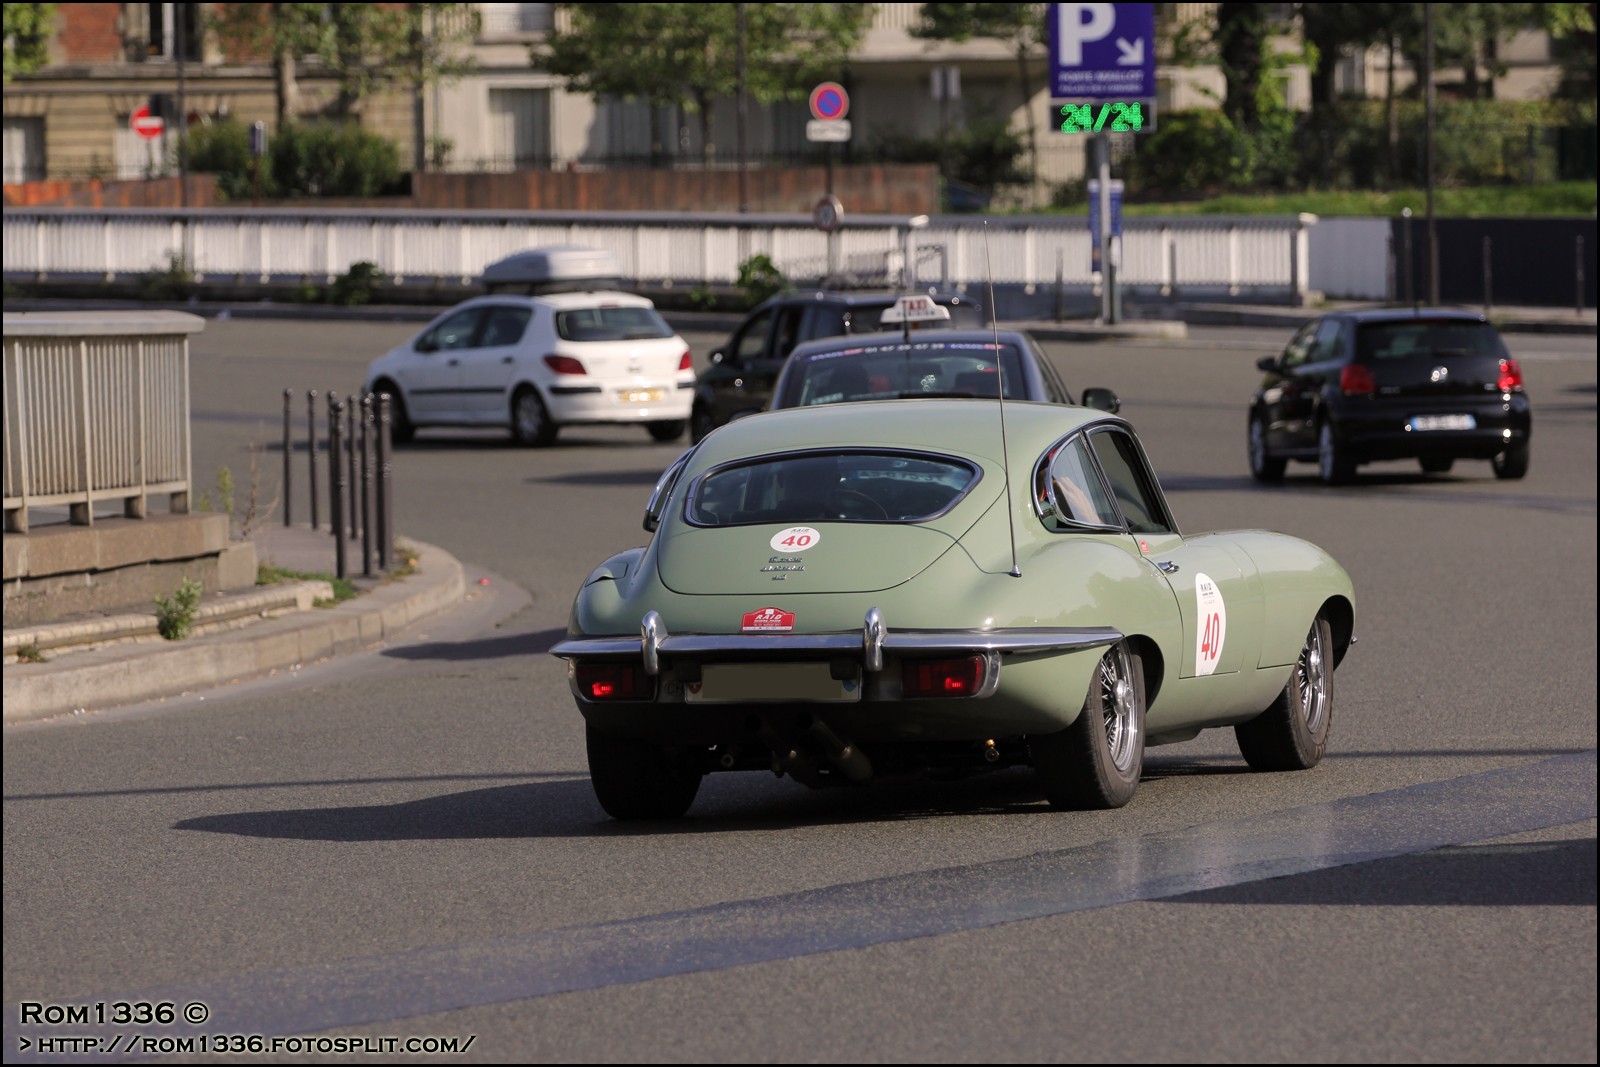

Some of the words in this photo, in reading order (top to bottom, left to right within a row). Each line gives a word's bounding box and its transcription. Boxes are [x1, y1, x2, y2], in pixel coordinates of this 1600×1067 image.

[1058, 3, 1116, 66] P
[1060, 102, 1144, 133] 24/24
[781, 535, 811, 546] 40
[1201, 612, 1220, 661] 40
